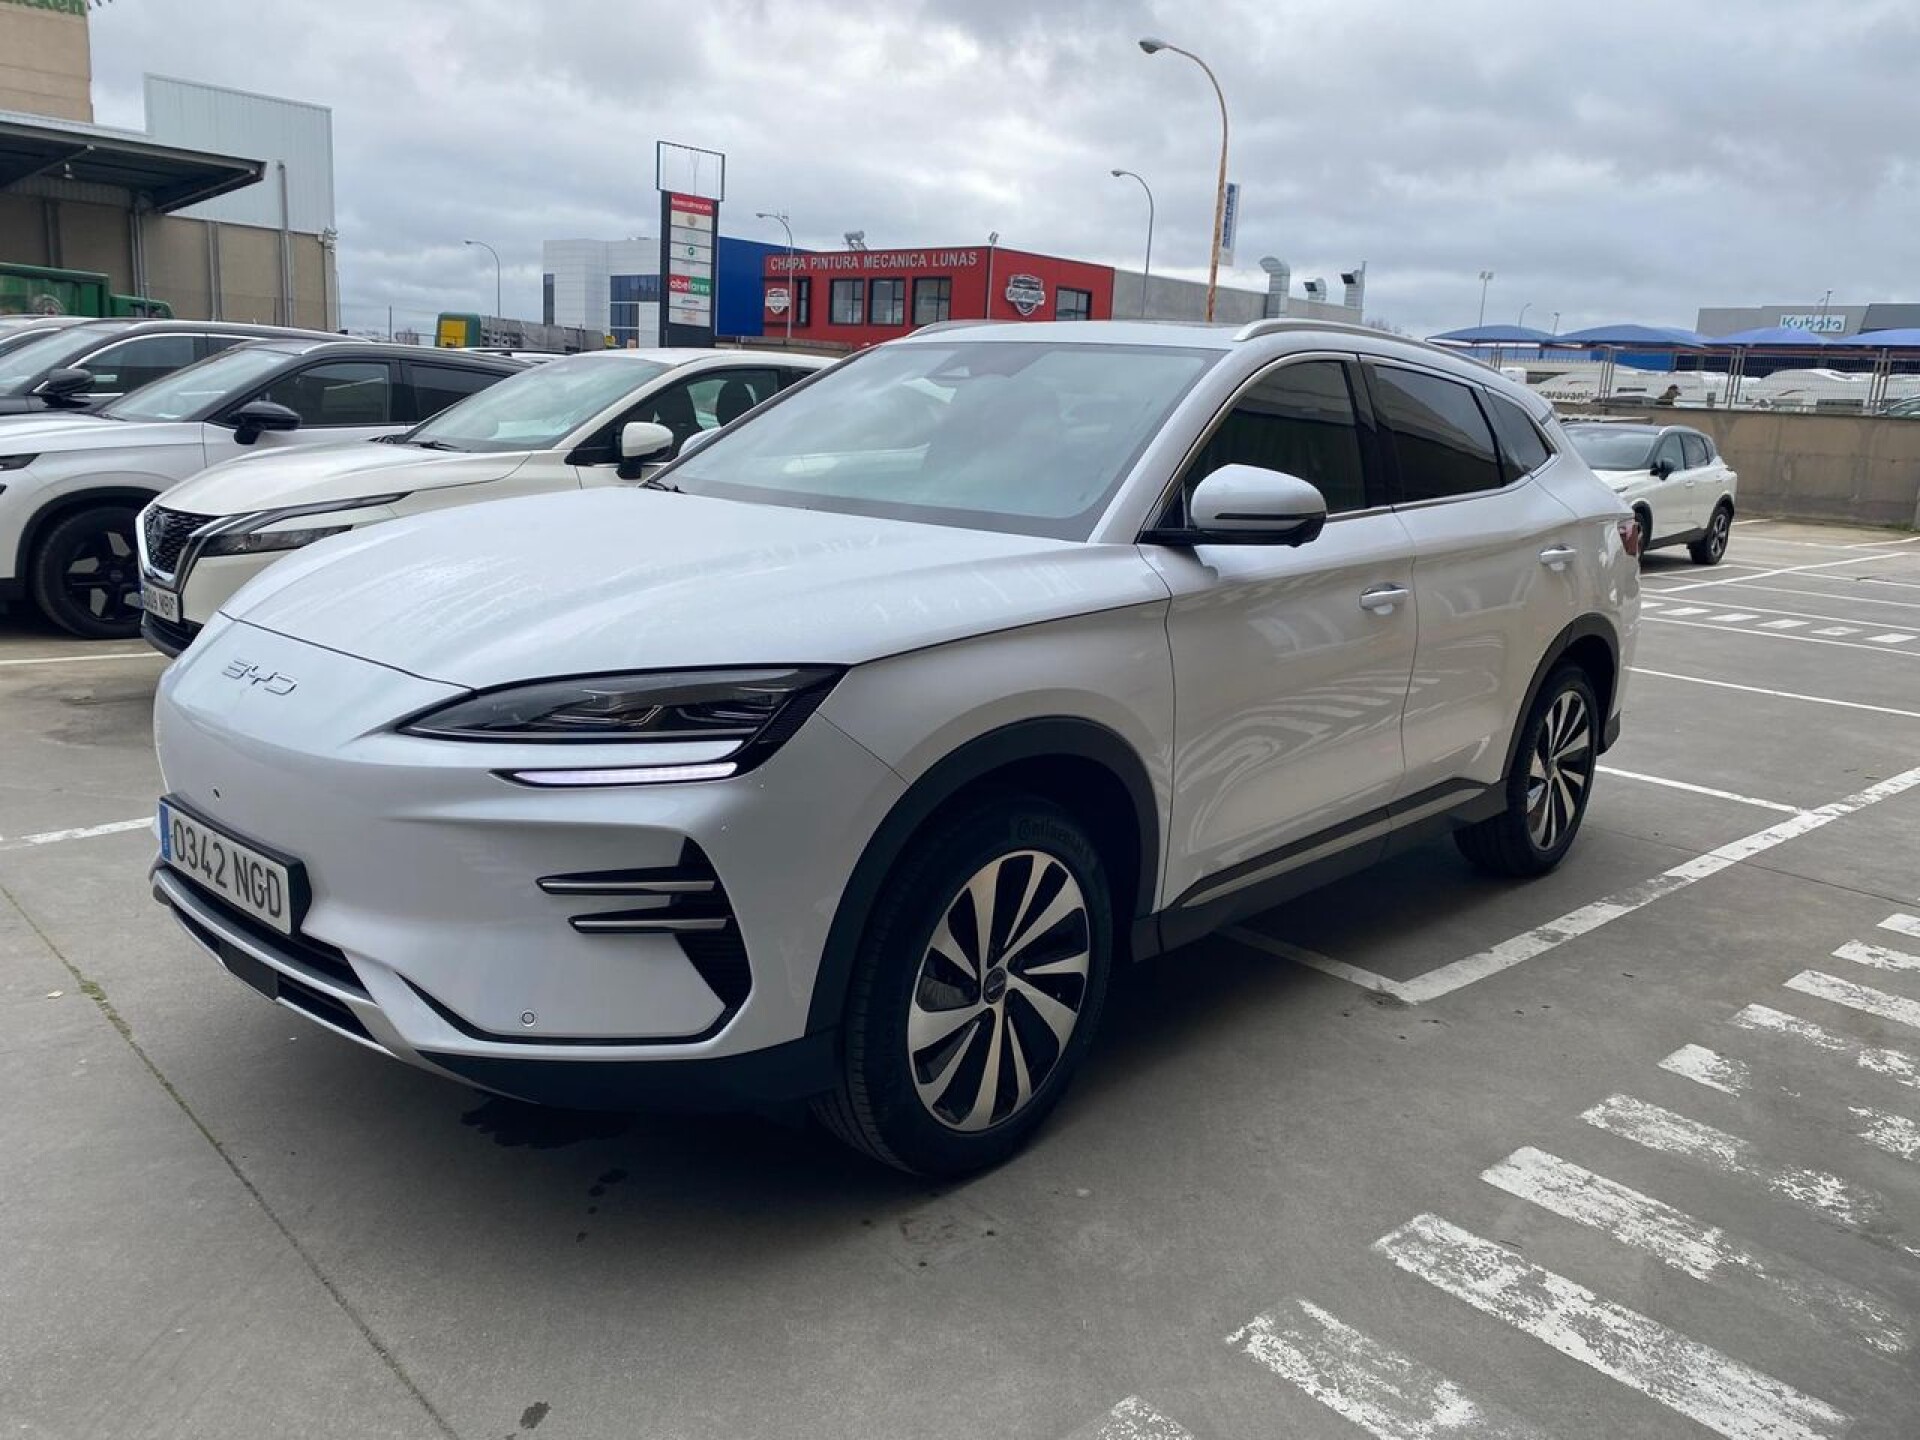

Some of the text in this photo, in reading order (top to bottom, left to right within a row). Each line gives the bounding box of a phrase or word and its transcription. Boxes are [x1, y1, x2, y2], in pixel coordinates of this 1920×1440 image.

[770, 251, 978, 271] CHAPA PINTURA MECANICA LUNAS
[1782, 316, 1842, 331] Kubota
[221, 658, 298, 697] BYD
[173, 819, 282, 918] 0342 NGD
